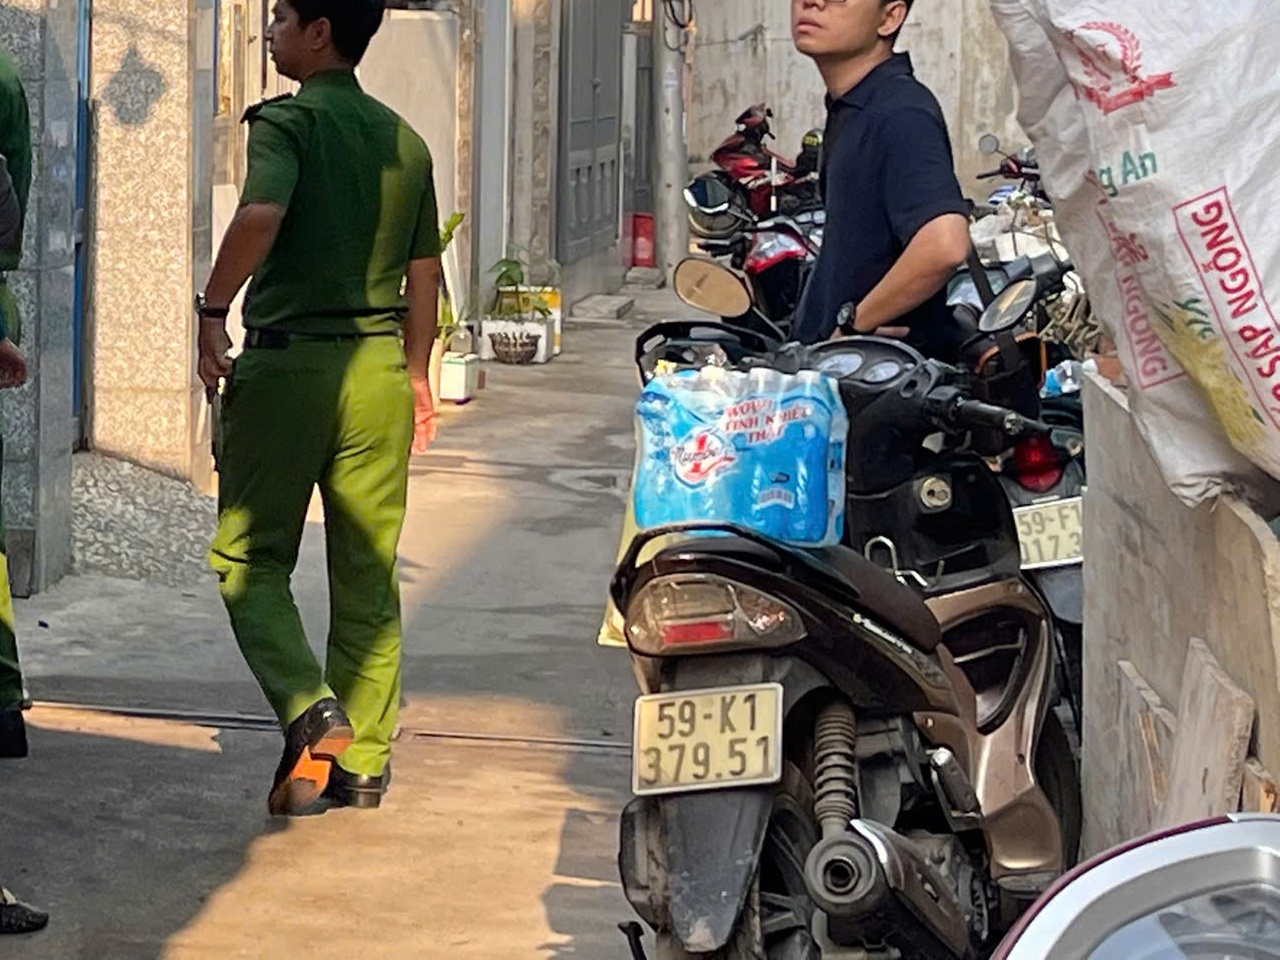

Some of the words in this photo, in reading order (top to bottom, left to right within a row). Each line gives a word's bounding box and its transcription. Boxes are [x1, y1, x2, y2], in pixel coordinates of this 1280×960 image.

[1122, 150, 1157, 185] An
[1191, 200, 1258, 319] NGỖNG
[1017, 504, 1081, 536] 59-F1
[657, 693, 757, 740] 59-K1
[641, 736, 770, 786] 379.51
